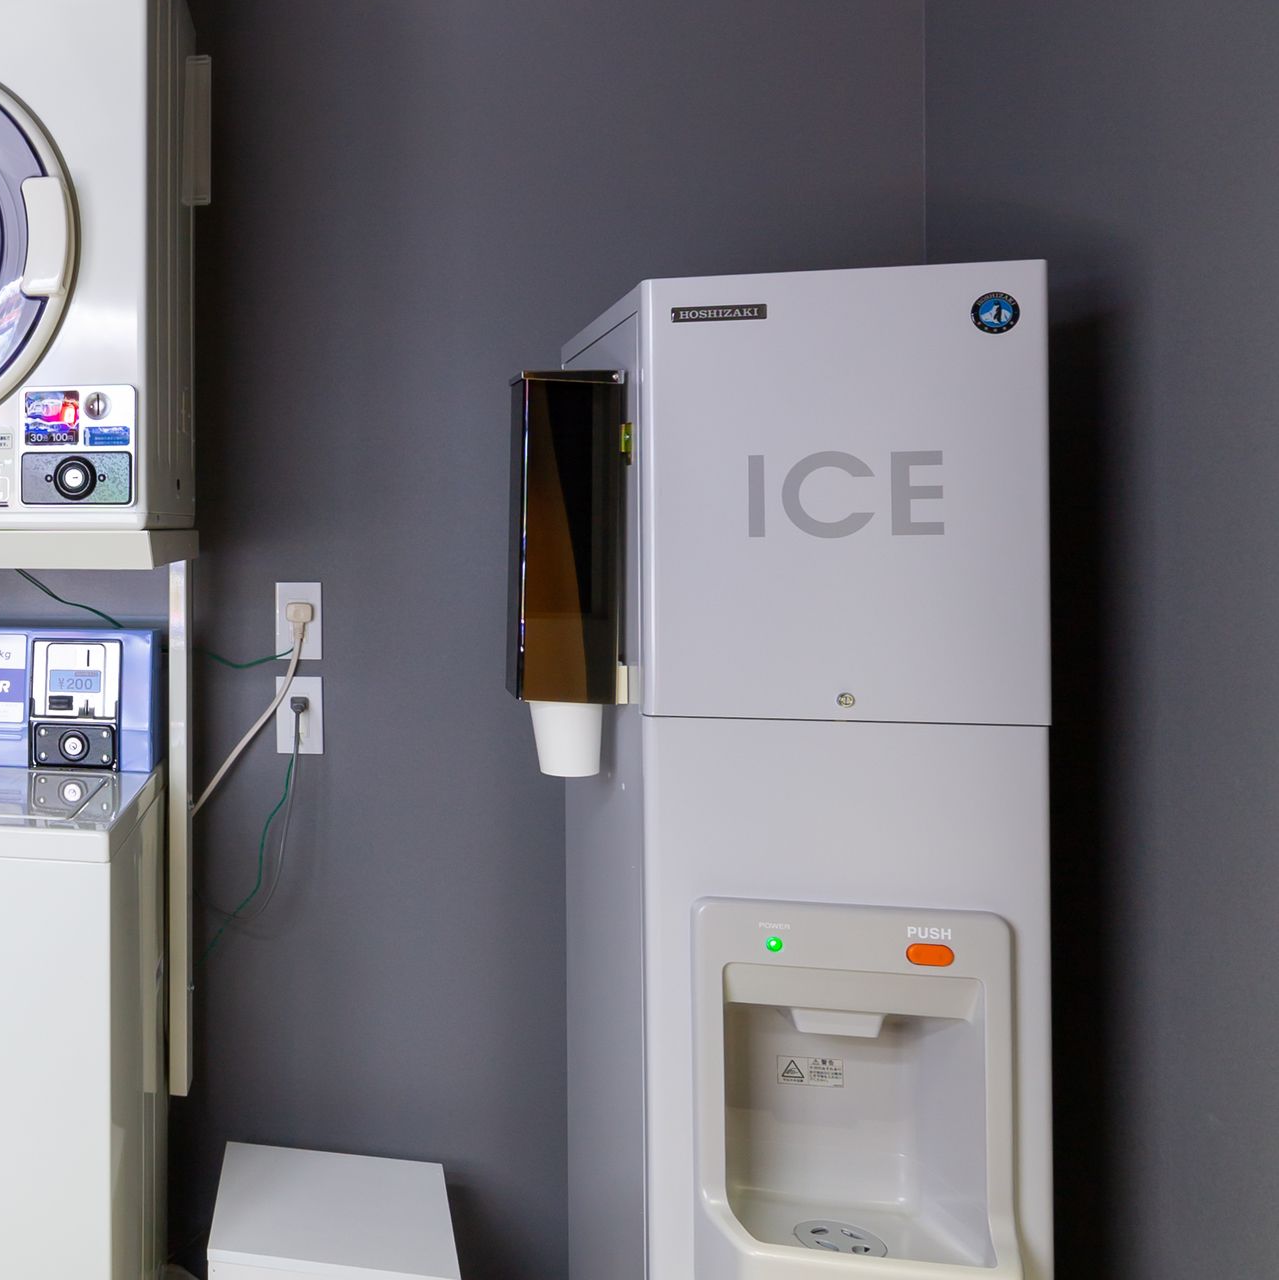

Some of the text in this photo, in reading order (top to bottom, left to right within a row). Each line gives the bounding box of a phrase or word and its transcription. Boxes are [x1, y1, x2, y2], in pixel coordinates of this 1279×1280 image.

[679, 307, 759, 320] HOSHIZAKI
[747, 450, 945, 539] ICE
[57, 677, 93, 691] ¥200
[758, 921, 791, 930] POWER
[906, 926, 952, 940] PUSH
